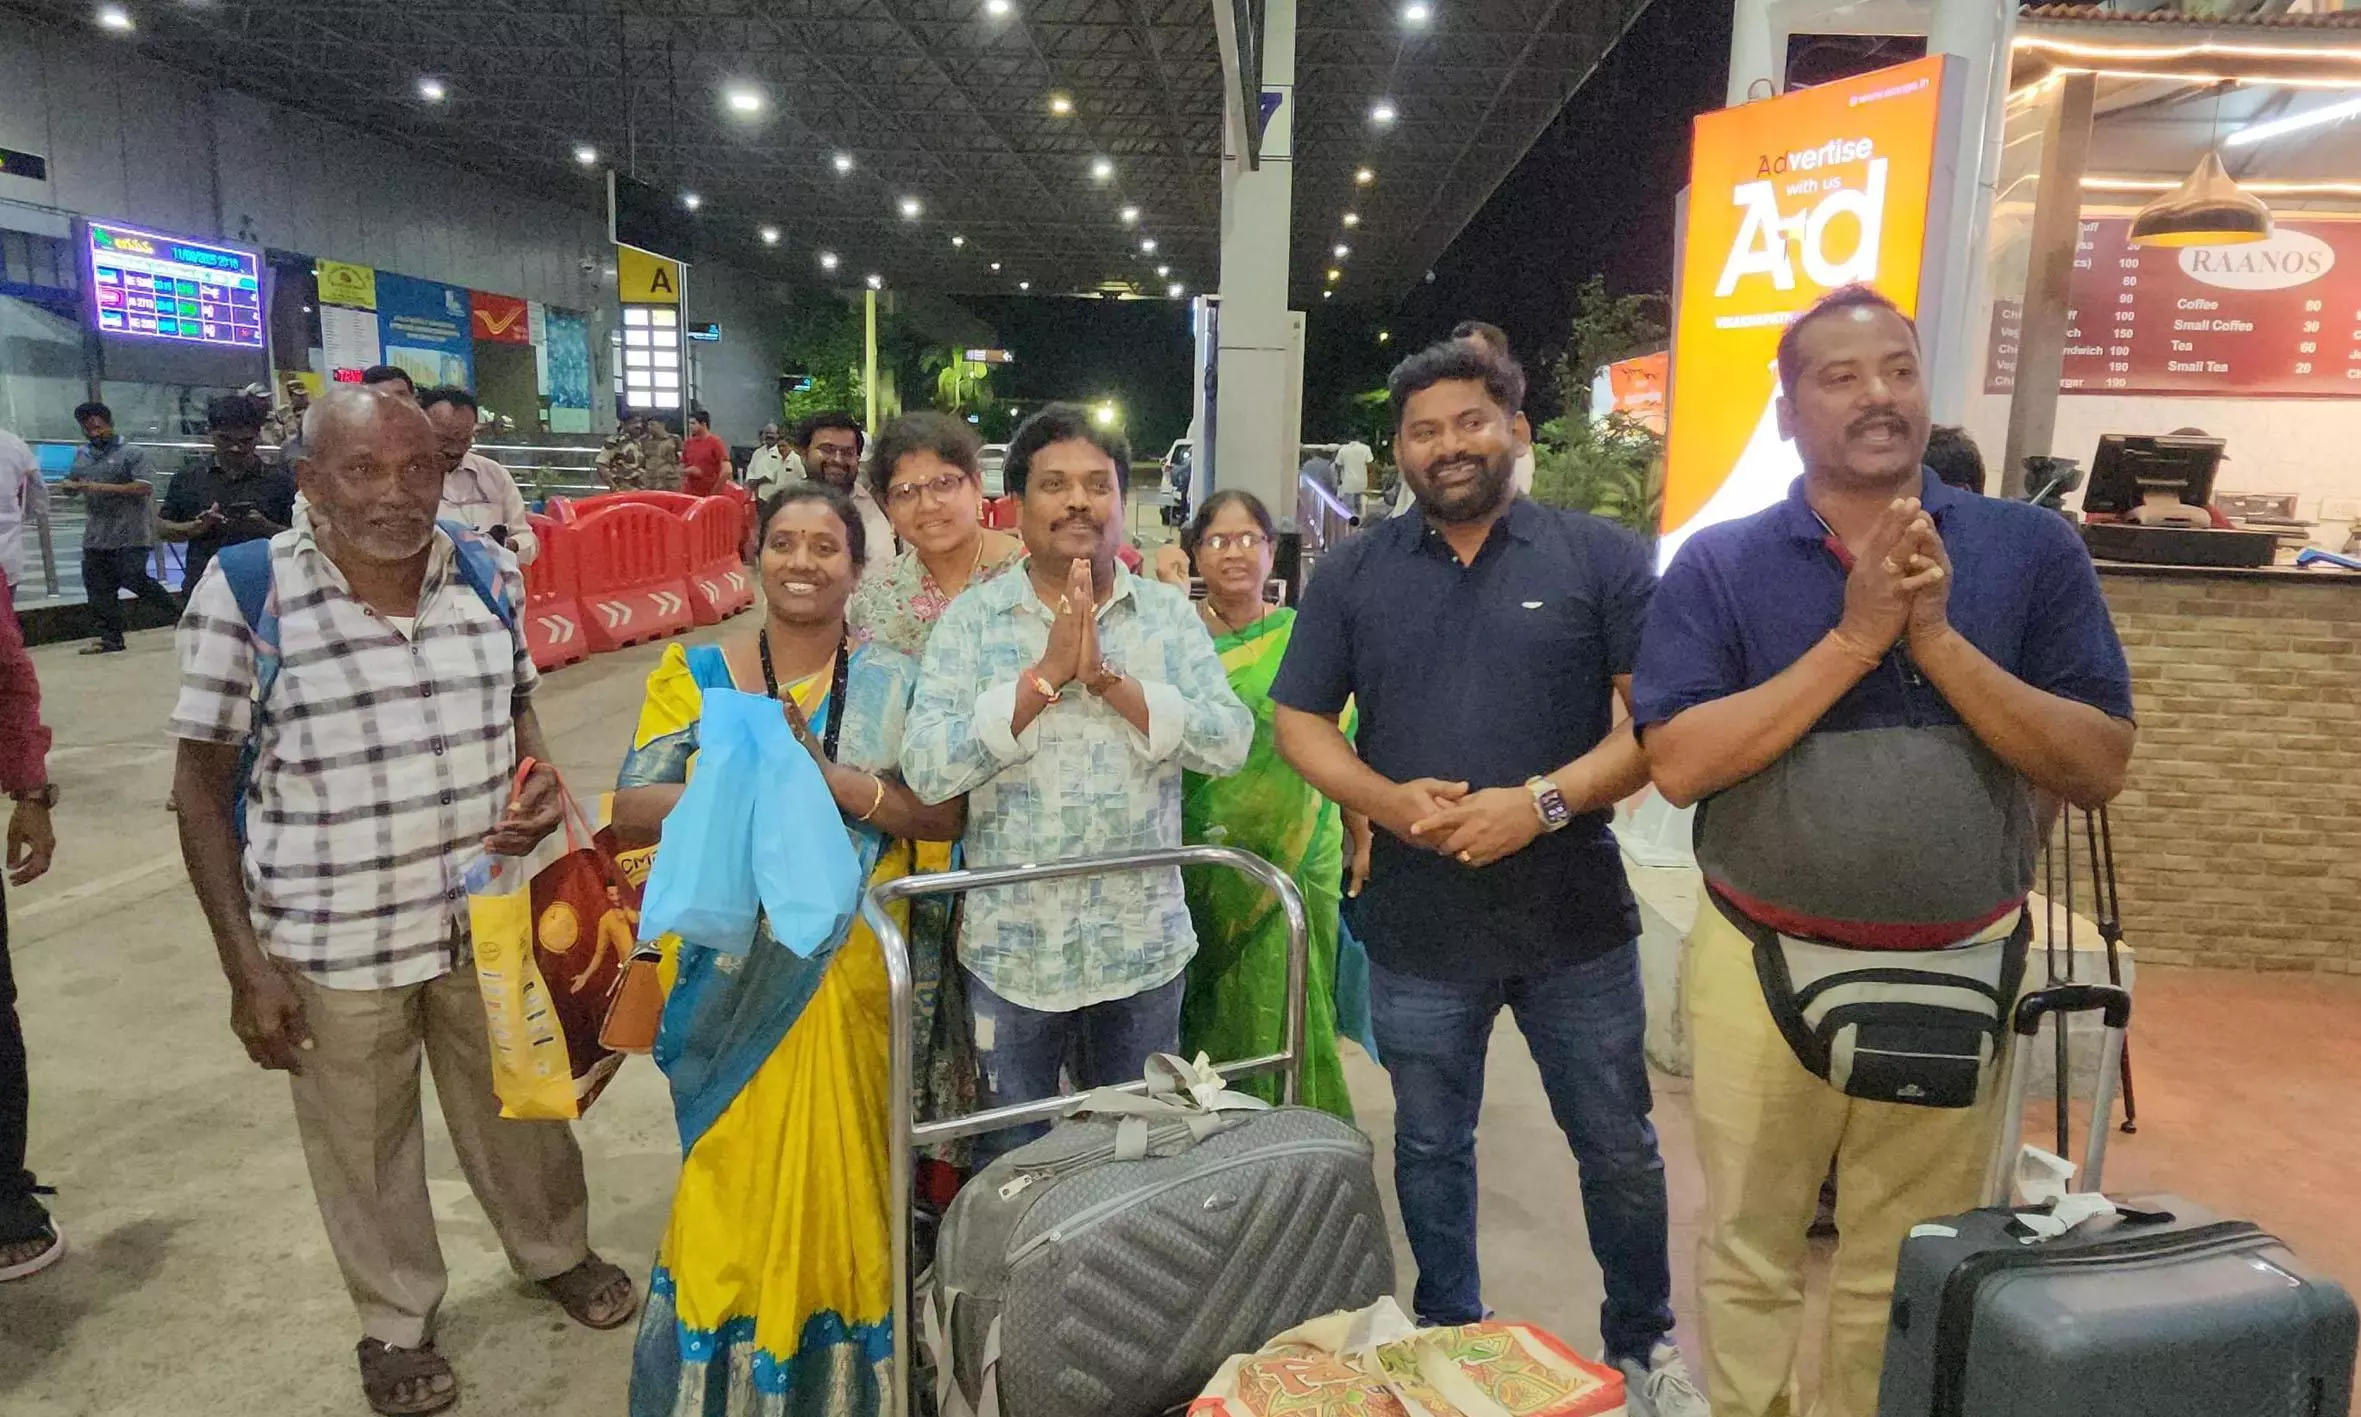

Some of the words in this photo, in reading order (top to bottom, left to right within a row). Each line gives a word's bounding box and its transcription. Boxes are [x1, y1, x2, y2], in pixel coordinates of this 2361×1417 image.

[1757, 137, 1873, 178] Advertise
[1786, 178, 1818, 196] with
[1823, 176, 1841, 190] us
[2119, 258, 2139, 268] 100
[2192, 250, 2323, 274] RAANOS
[650, 267, 673, 293] A
[2177, 298, 2218, 310] Coffee
[2115, 311, 2135, 321] 100
[2174, 319, 2209, 331] Small
[2212, 319, 2254, 332] Coffee
[2114, 328, 2134, 338] 150
[2063, 345, 2103, 355] ndwich
[2171, 339, 2193, 351] Tea
[2168, 360, 2203, 372] Small
[2206, 361, 2229, 373] Tea
[2295, 362, 2312, 374] 20
[2060, 378, 2085, 388] rger
